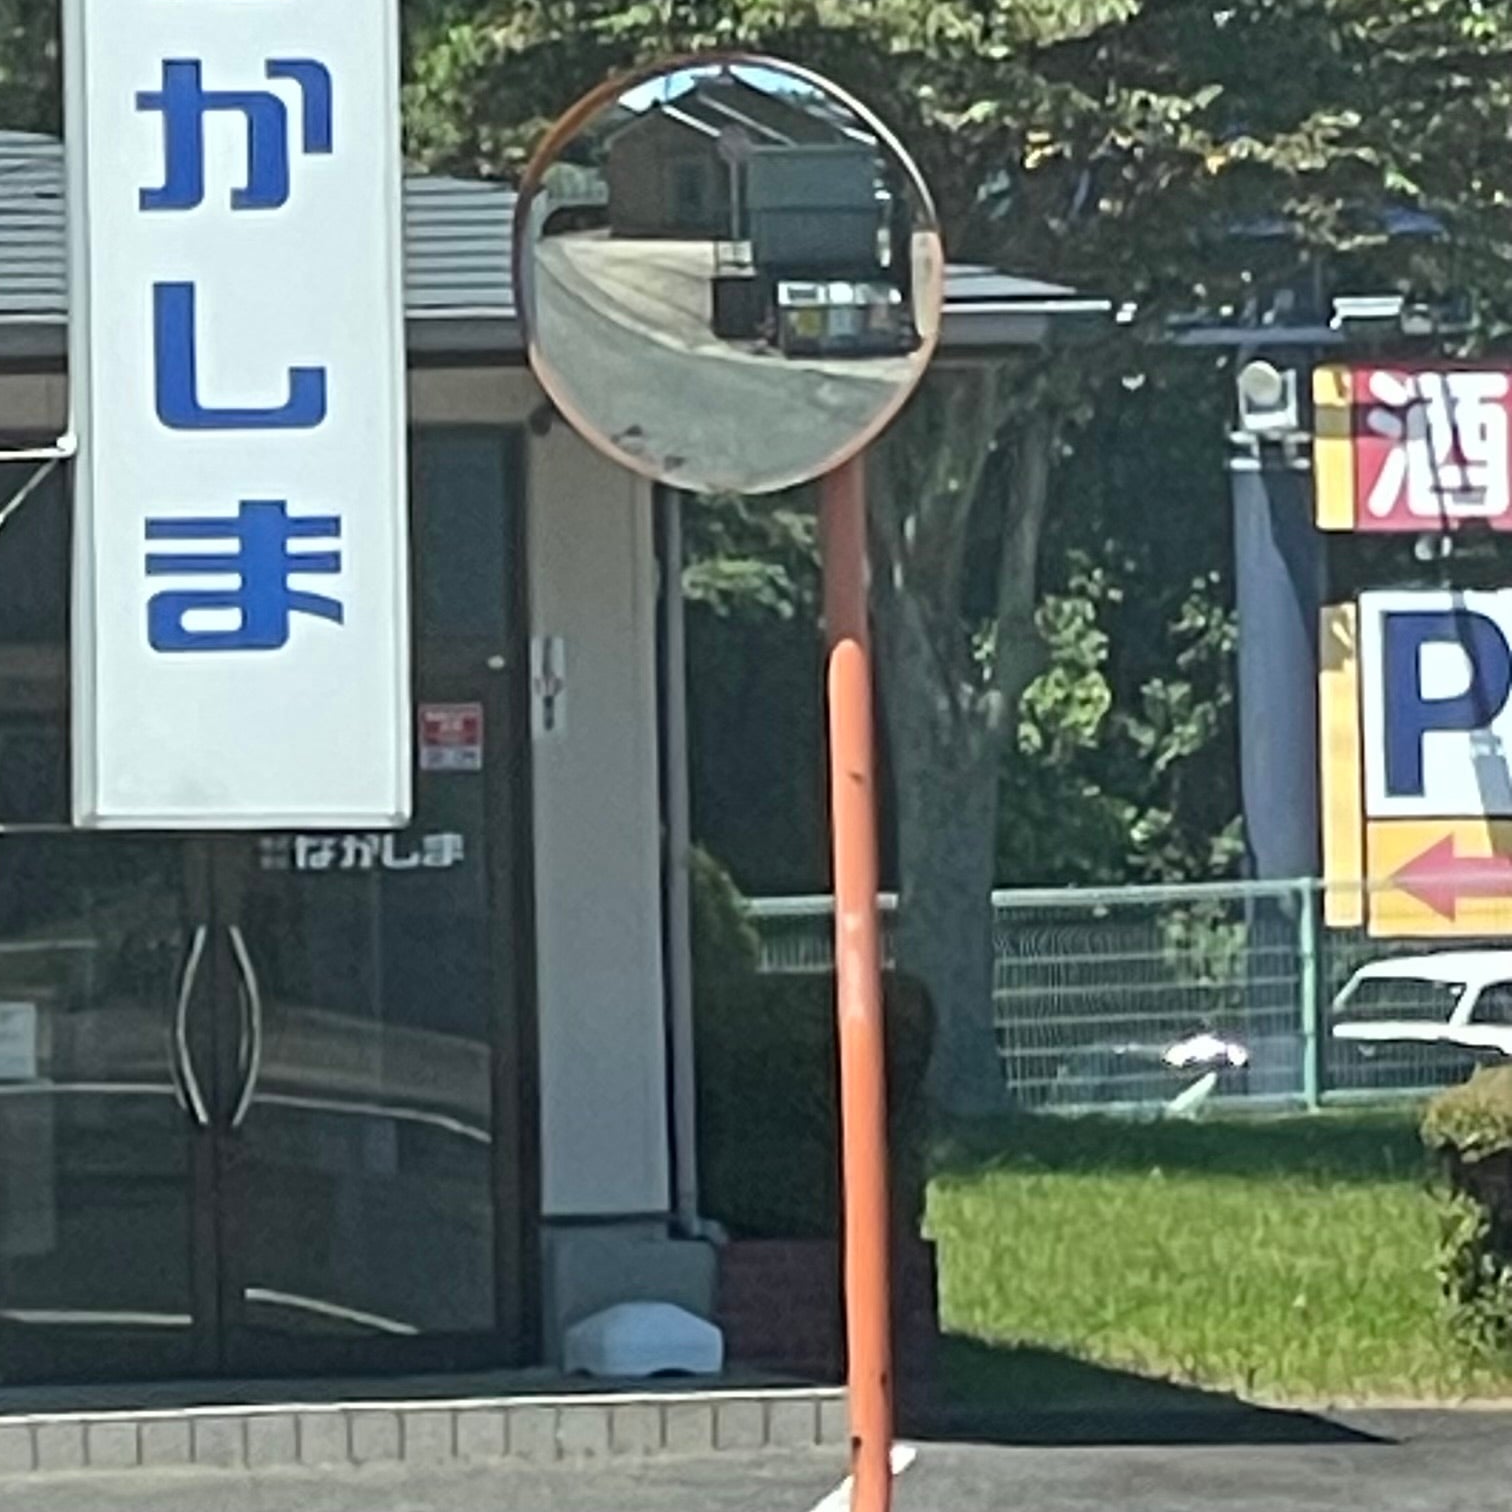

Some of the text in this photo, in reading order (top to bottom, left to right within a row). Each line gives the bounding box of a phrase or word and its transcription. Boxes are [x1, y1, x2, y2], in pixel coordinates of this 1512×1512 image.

[1366, 370, 1510, 519] 酒
[1380, 609, 1512, 798] P
[294, 833, 465, 870] なかしま
